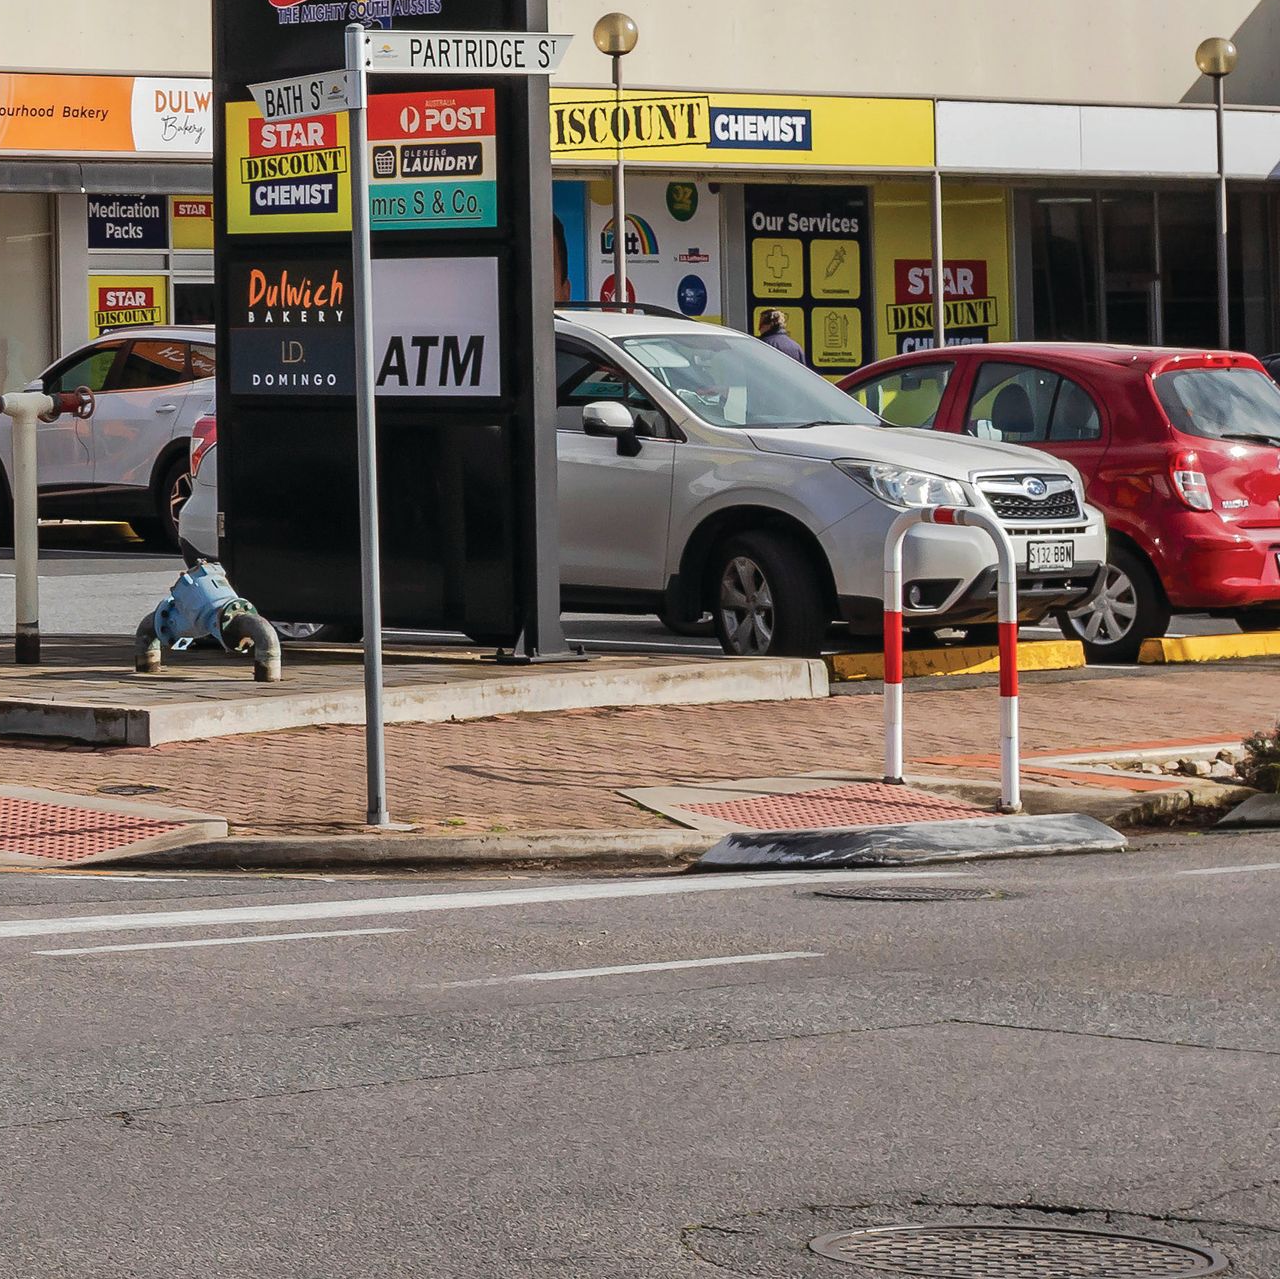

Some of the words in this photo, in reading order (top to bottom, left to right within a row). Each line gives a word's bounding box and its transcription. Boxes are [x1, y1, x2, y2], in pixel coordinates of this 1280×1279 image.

[277, 7, 299, 24] THE
[301, 3, 348, 23] MIGHTY
[349, 0, 390, 19] SOUTH
[410, 39, 526, 68] PARTRIDGE
[538, 40, 557, 68] ST
[154, 90, 213, 114] DULW
[265, 84, 303, 117] BATH
[310, 81, 324, 110] ST
[425, 99, 456, 107] AUSTRALIA
[62, 105, 109, 121] Bakery
[425, 106, 486, 132] POST
[554, 102, 701, 145] ISCOUNT
[714, 114, 806, 143] CHEMIST
[161, 116, 206, 144] Bakery
[261, 122, 325, 148] STAR
[246, 149, 341, 180] DISCOUNT
[402, 155, 478, 172] LAUNDRY
[404, 149, 447, 157] GLENELG
[254, 183, 332, 207] CHEMIST
[372, 197, 406, 215] mrs
[414, 190, 424, 214] S
[432, 190, 445, 214] &
[452, 189, 482, 213] Co.
[89, 202, 159, 218] Medication
[179, 204, 206, 215] STAR
[105, 222, 143, 238] Packs
[752, 211, 784, 232] Our
[788, 213, 859, 233] Services
[106, 291, 146, 306] STAR
[248, 268, 344, 308] Dulwich
[97, 308, 156, 325] DISCOUNT
[248, 310, 344, 324] BAKERY
[376, 335, 485, 387] ATM
[252, 374, 337, 386] DOMINGO
